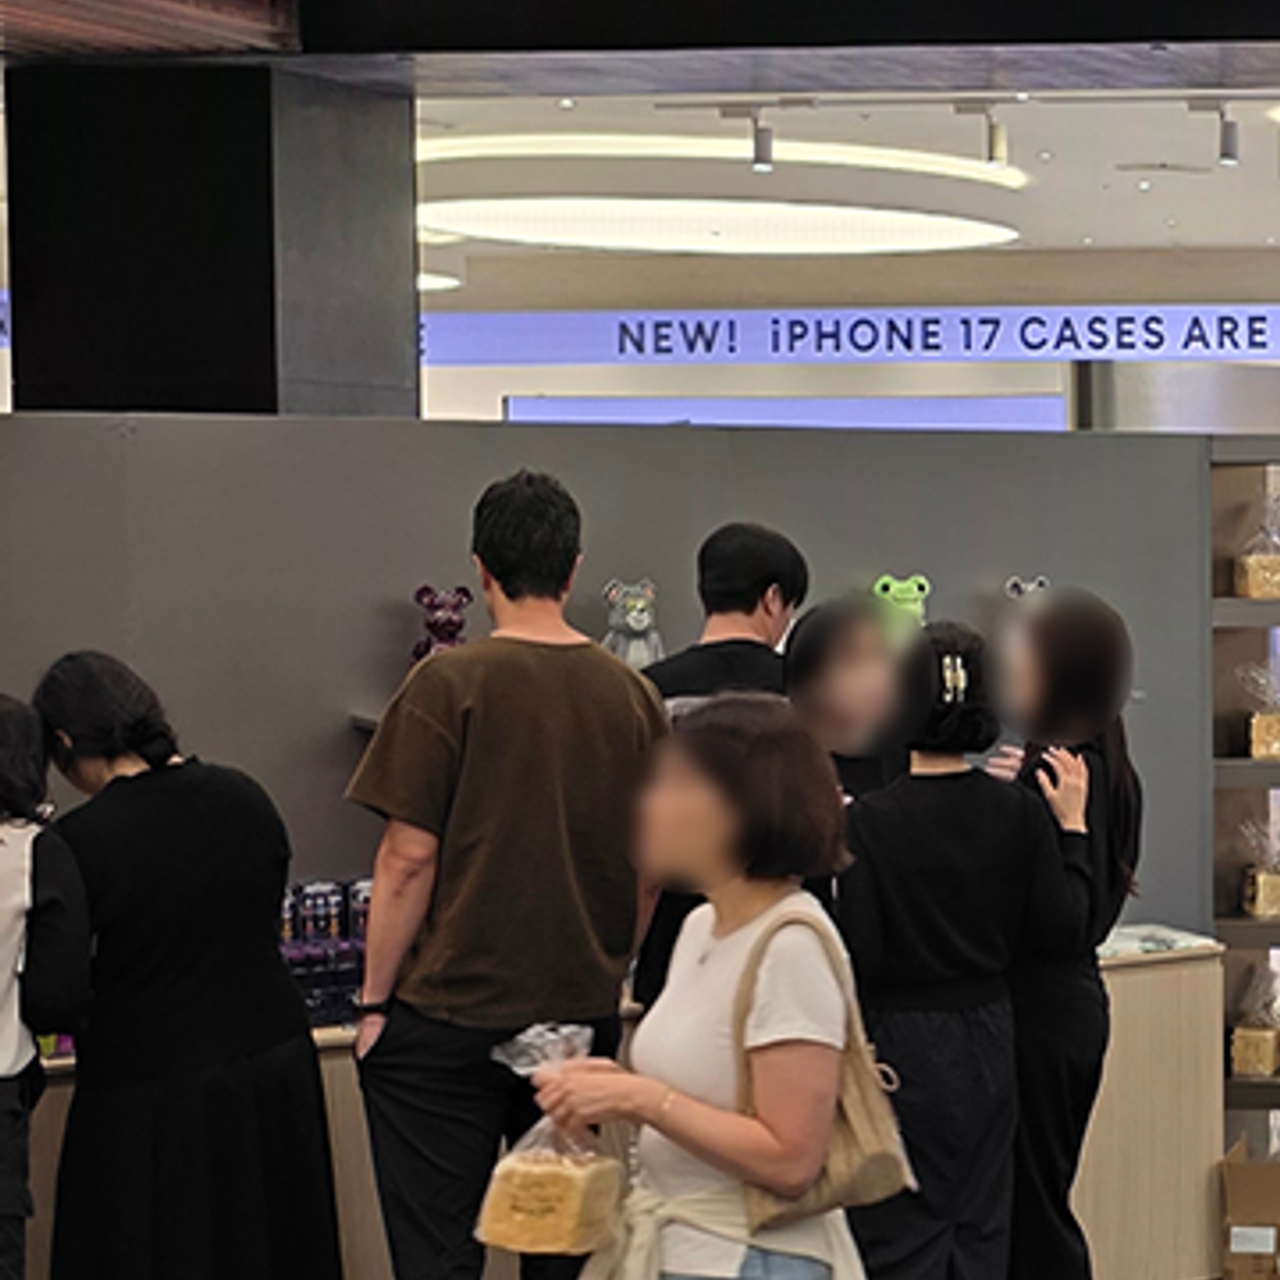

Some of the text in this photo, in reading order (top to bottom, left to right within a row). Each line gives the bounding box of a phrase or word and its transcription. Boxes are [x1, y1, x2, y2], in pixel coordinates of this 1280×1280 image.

[618, 321, 737, 354] NEW!
[770, 318, 942, 353] iPHONE
[960, 318, 1001, 351] 17
[1019, 316, 1165, 350] CASES
[1182, 316, 1268, 349] ARE
